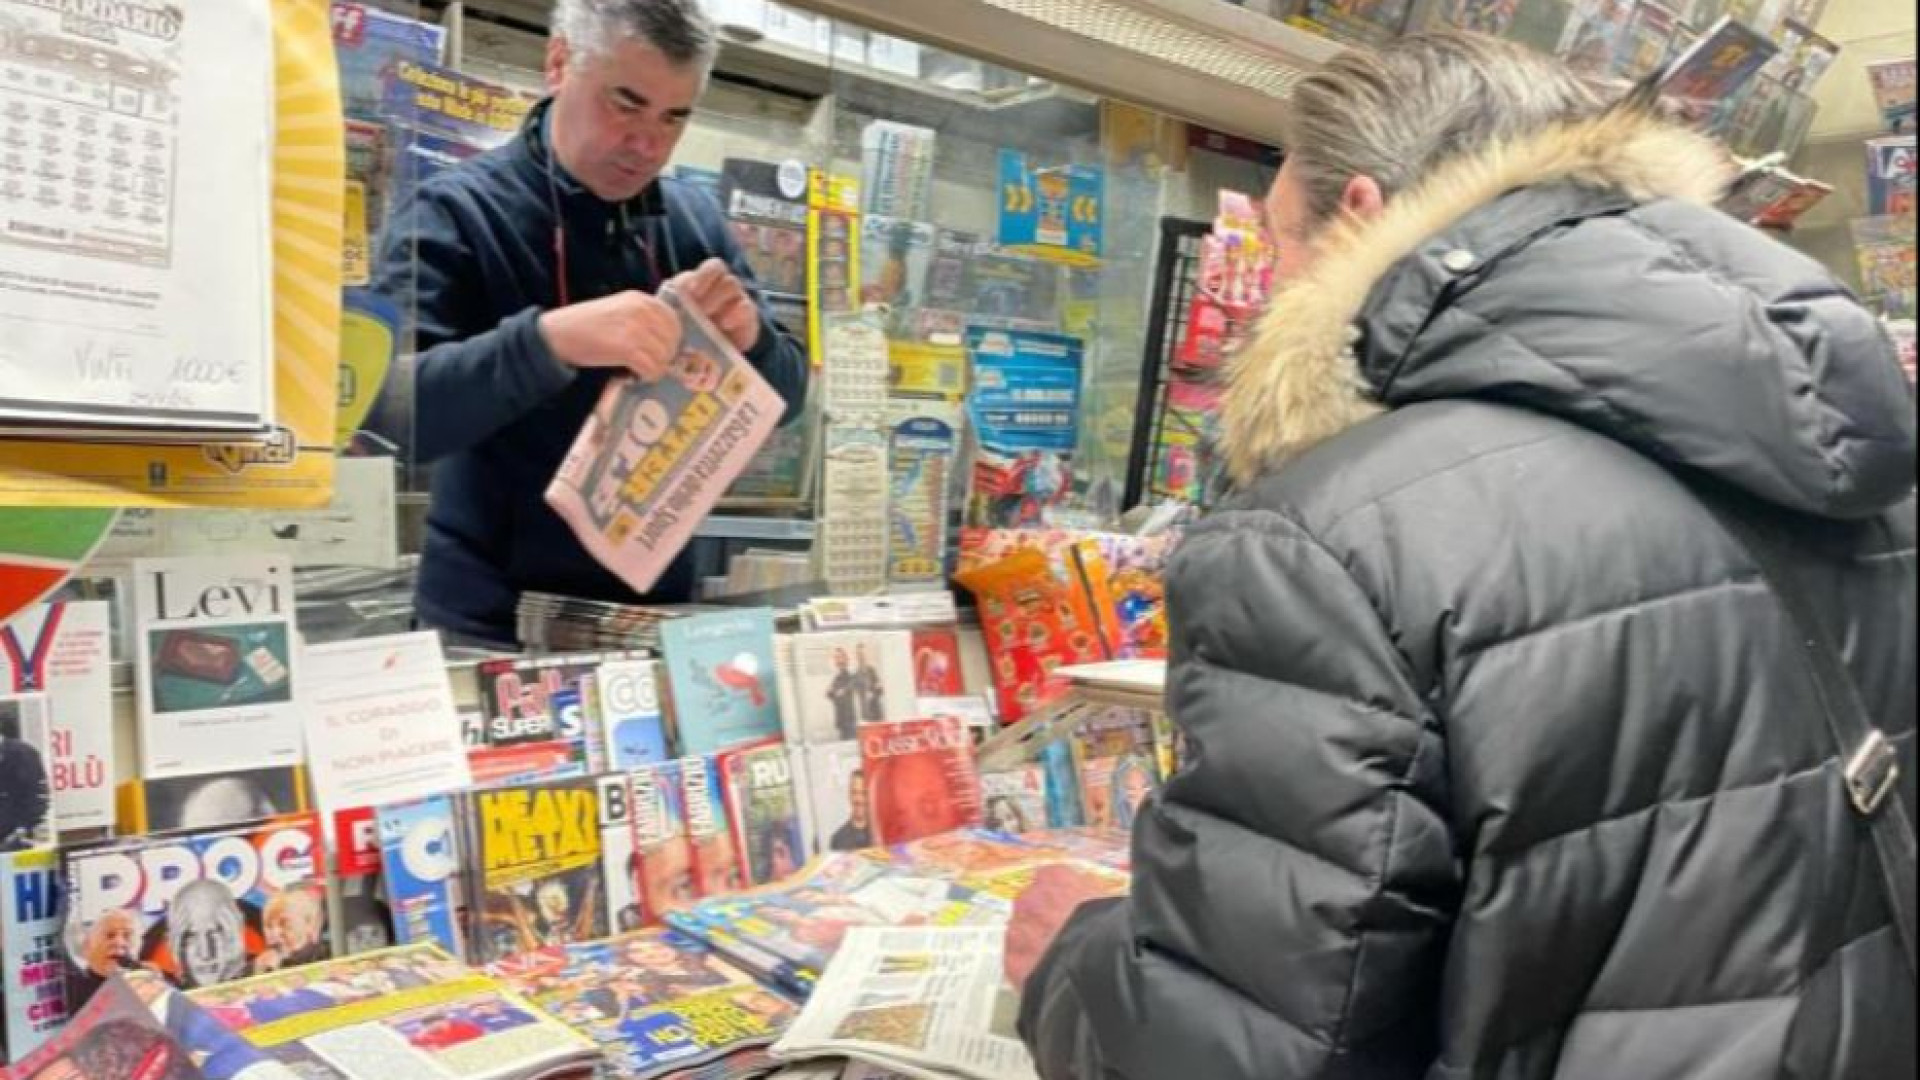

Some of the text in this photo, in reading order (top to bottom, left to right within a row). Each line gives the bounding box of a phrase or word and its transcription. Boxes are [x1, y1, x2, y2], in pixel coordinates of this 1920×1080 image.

[150, 567, 281, 619] Levi
[332, 740, 450, 770] NON PIACERE
[75, 828, 314, 930] PROG
